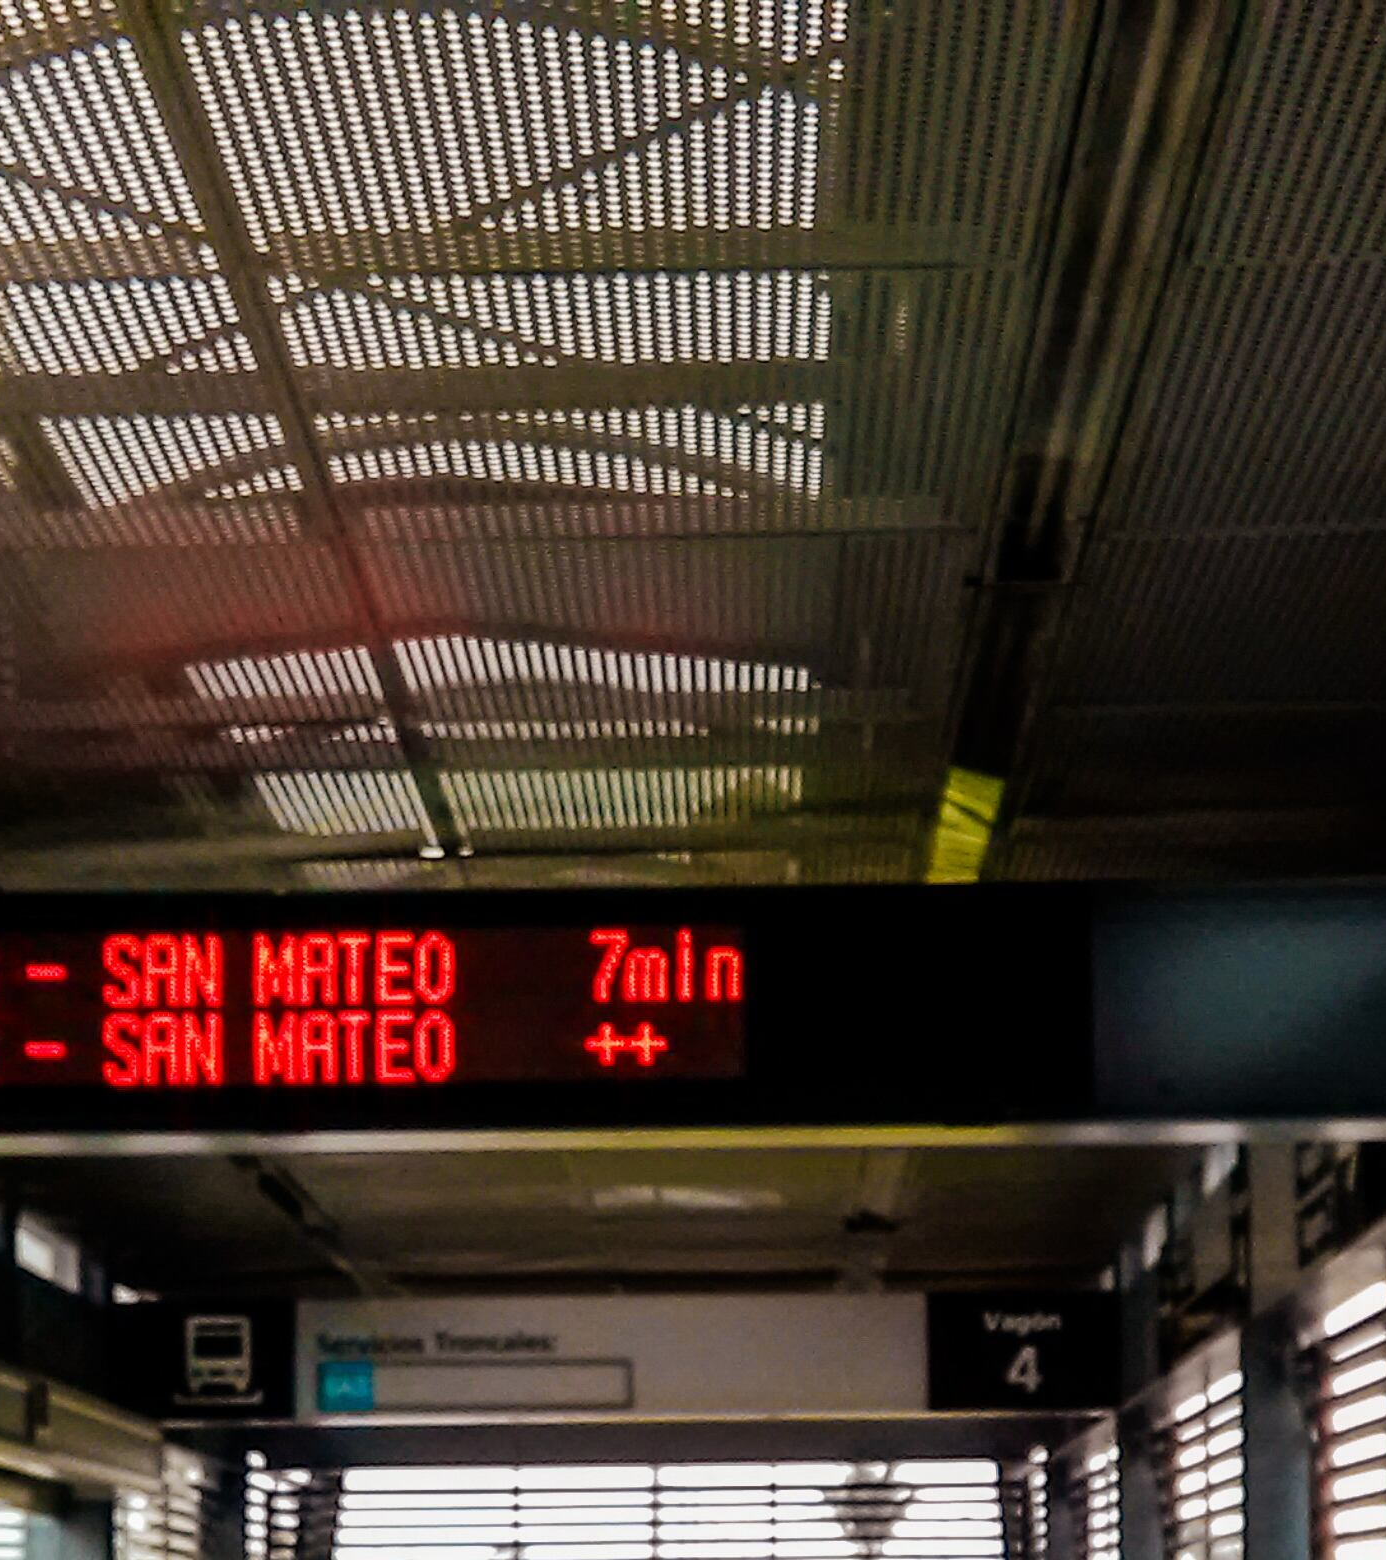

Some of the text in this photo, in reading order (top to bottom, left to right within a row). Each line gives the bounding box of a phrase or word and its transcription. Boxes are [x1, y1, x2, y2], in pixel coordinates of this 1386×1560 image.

[101, 933, 224, 1009] SAN
[252, 931, 456, 1007] MATEO
[588, 926, 744, 1003] 7min
[101, 1009, 224, 1086] SAN
[252, 1008, 456, 1085] MATEO
[982, 1311, 1061, 1336] Vagón
[1007, 1346, 1043, 1392] 4
